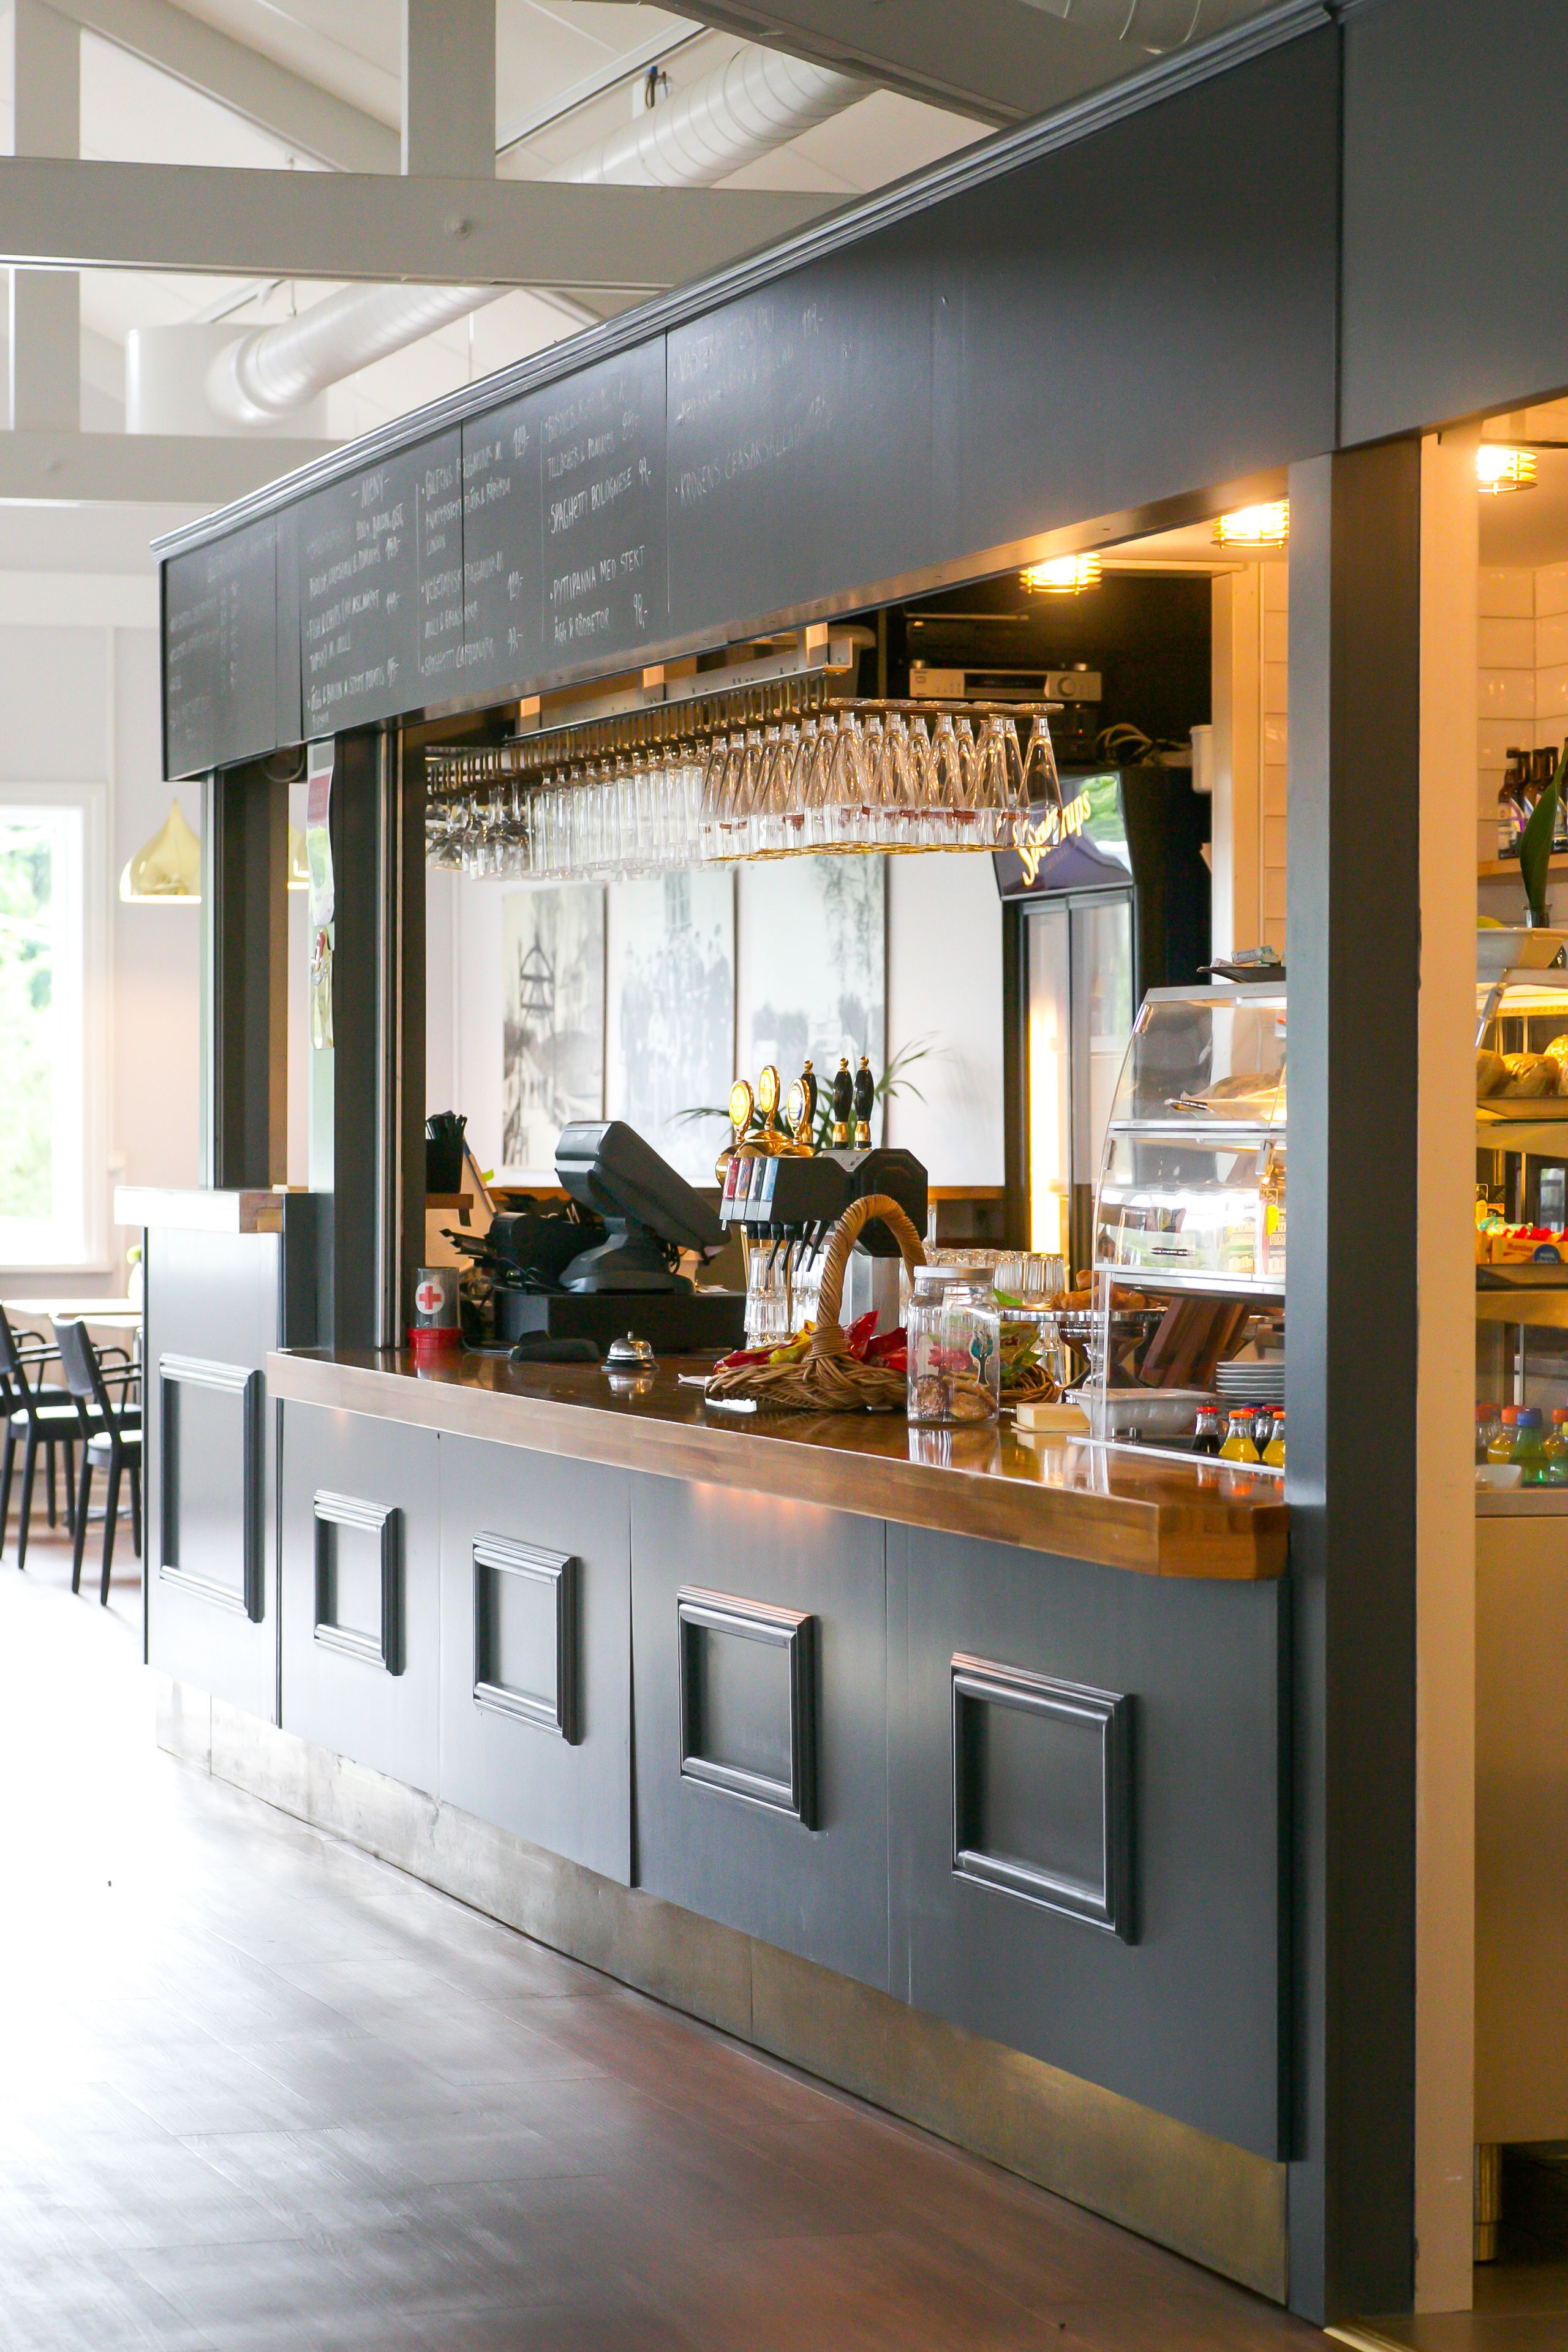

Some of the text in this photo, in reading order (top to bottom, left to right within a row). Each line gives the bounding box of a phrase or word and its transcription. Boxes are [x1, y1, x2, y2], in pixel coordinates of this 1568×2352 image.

[592, 466, 631, 510] BOLOGNESE
[554, 545, 645, 608] PYTTIPANNA MED STEKT
